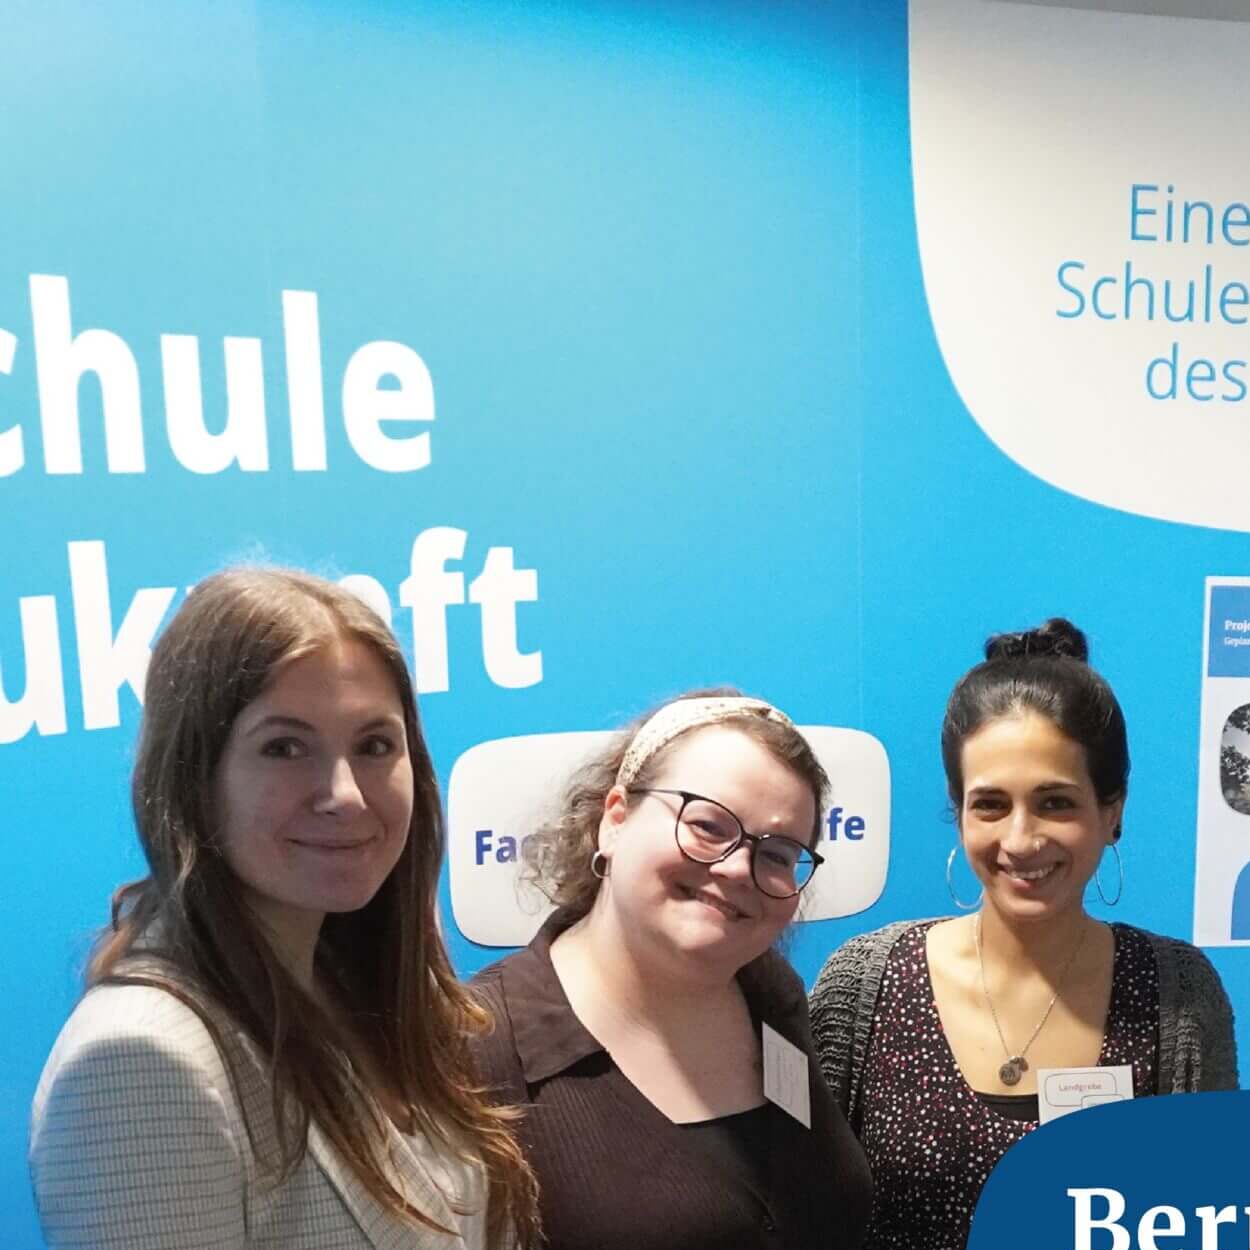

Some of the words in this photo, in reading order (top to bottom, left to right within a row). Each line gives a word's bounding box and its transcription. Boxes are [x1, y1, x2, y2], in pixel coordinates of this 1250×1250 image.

[1055, 261, 1250, 325] Schule
[1145, 342, 1249, 403] des
[0, 526, 544, 745] ukft
